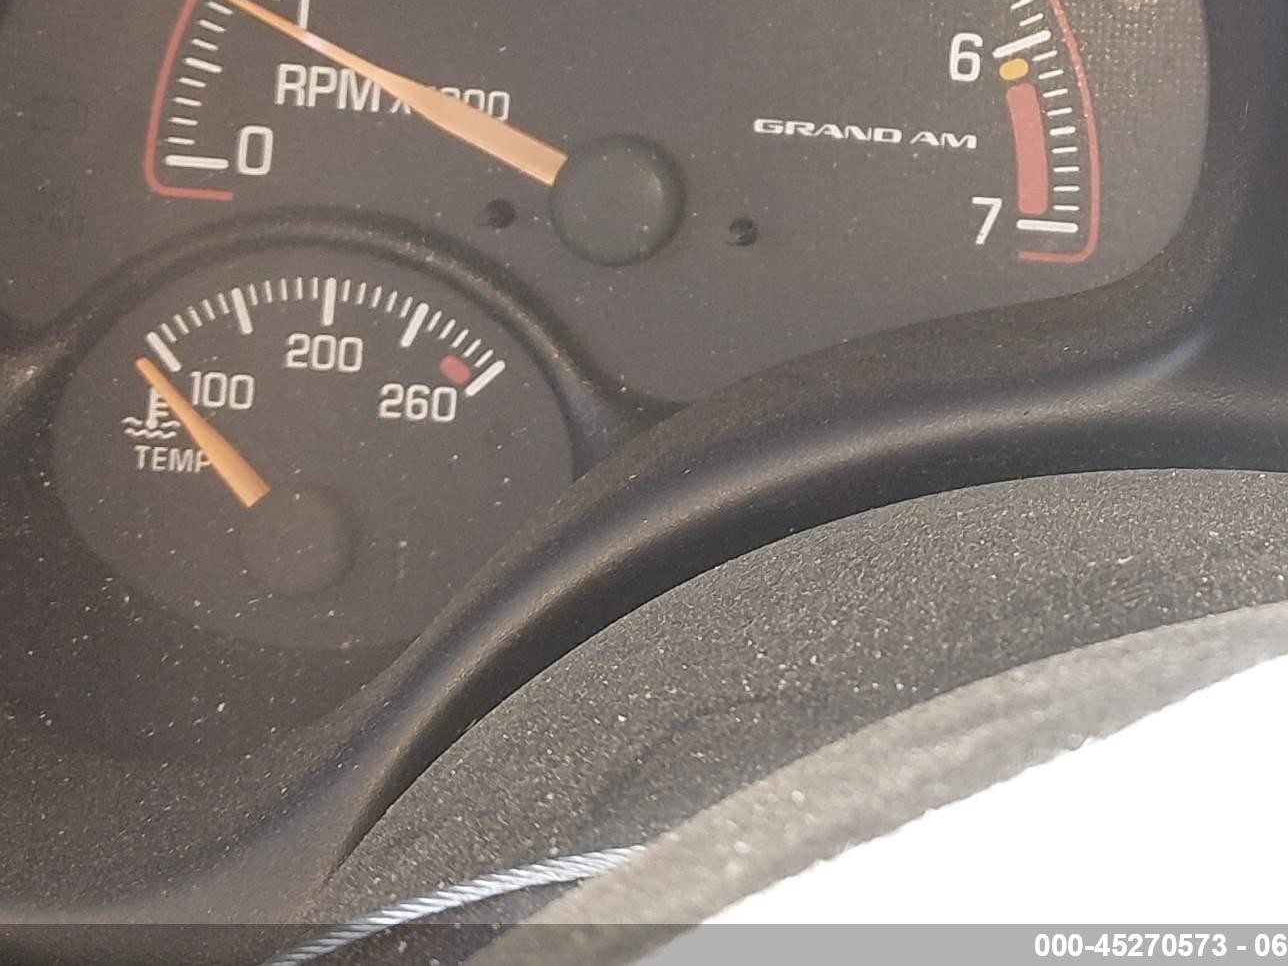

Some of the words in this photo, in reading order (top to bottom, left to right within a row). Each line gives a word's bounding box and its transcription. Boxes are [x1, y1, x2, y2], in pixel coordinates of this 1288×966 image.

[950, 33, 982, 81] 6
[276, 64, 380, 113] RPM
[238, 126, 273, 175] 0
[754, 119, 901, 143] GRAND
[911, 132, 976, 148] AM
[973, 197, 1002, 244] 7
[285, 333, 363, 372] 200
[191, 372, 255, 410] 100
[379, 384, 457, 422] 260
[135, 446, 212, 472] TEMP
